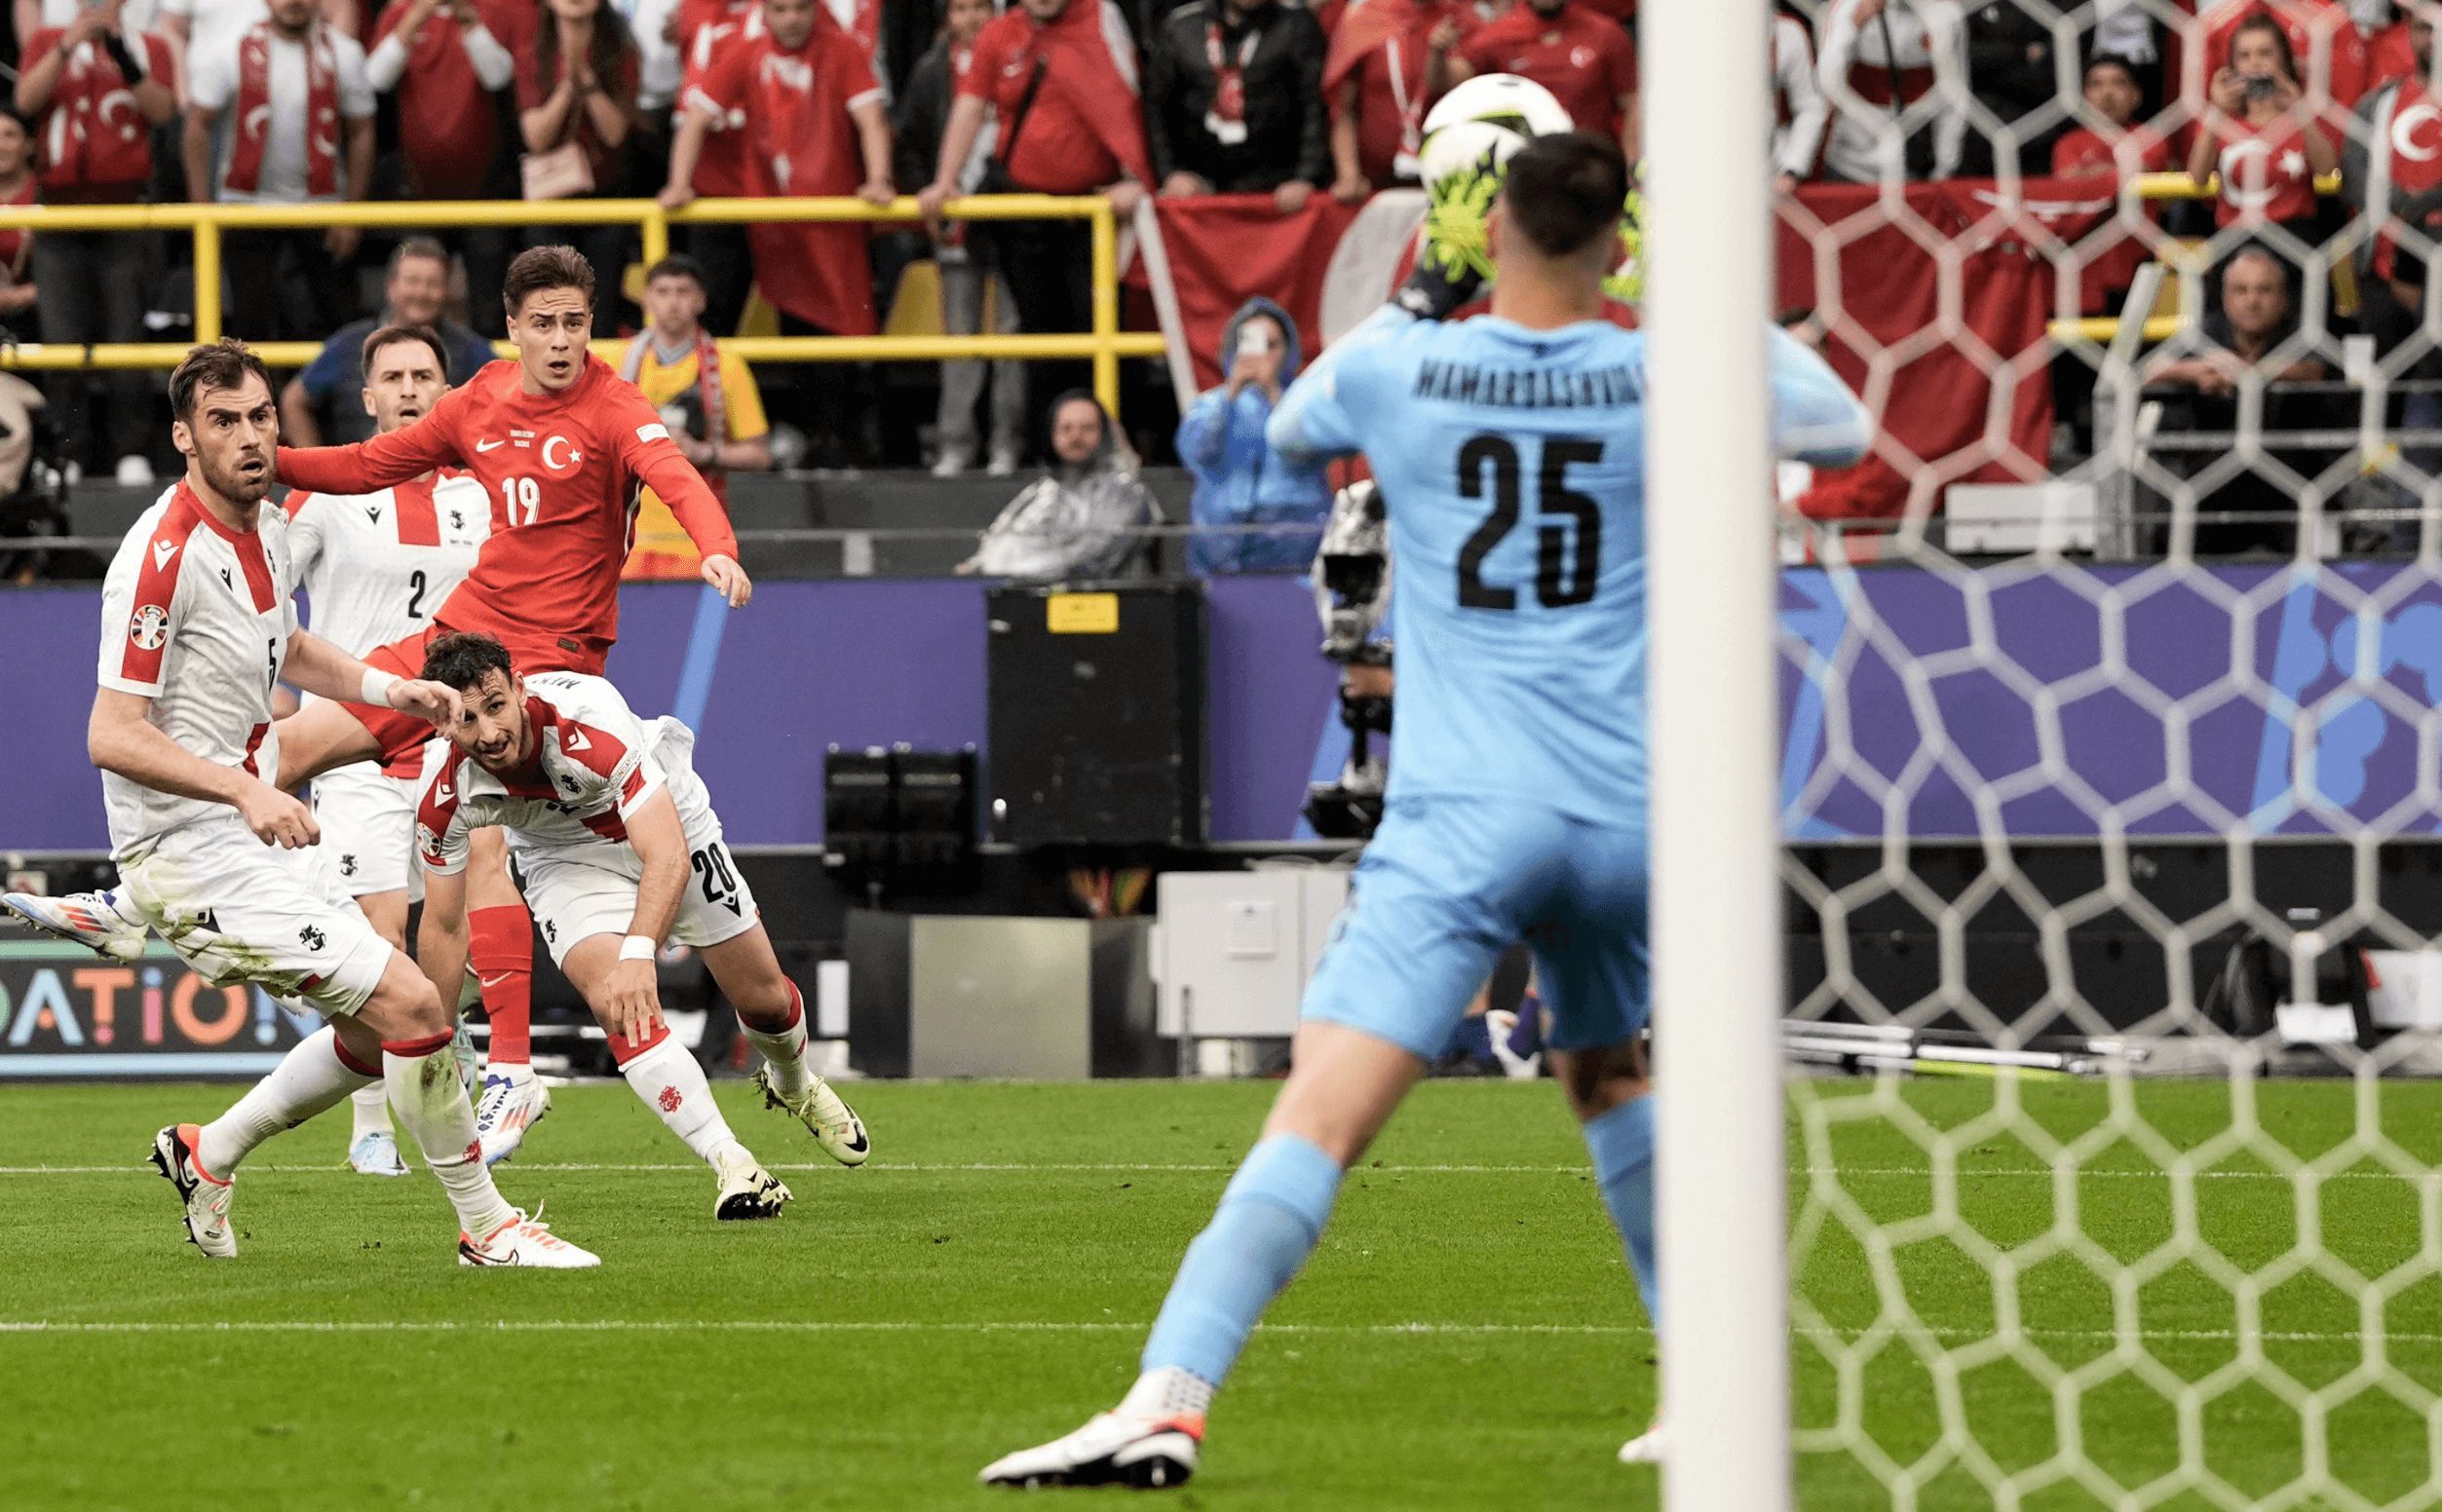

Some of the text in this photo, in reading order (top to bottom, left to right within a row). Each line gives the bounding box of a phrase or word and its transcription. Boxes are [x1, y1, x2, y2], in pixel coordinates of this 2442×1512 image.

[501, 476, 540, 527] 19
[1456, 433, 1605, 610] 25
[408, 570, 426, 618] 2
[691, 843, 737, 904] 20
